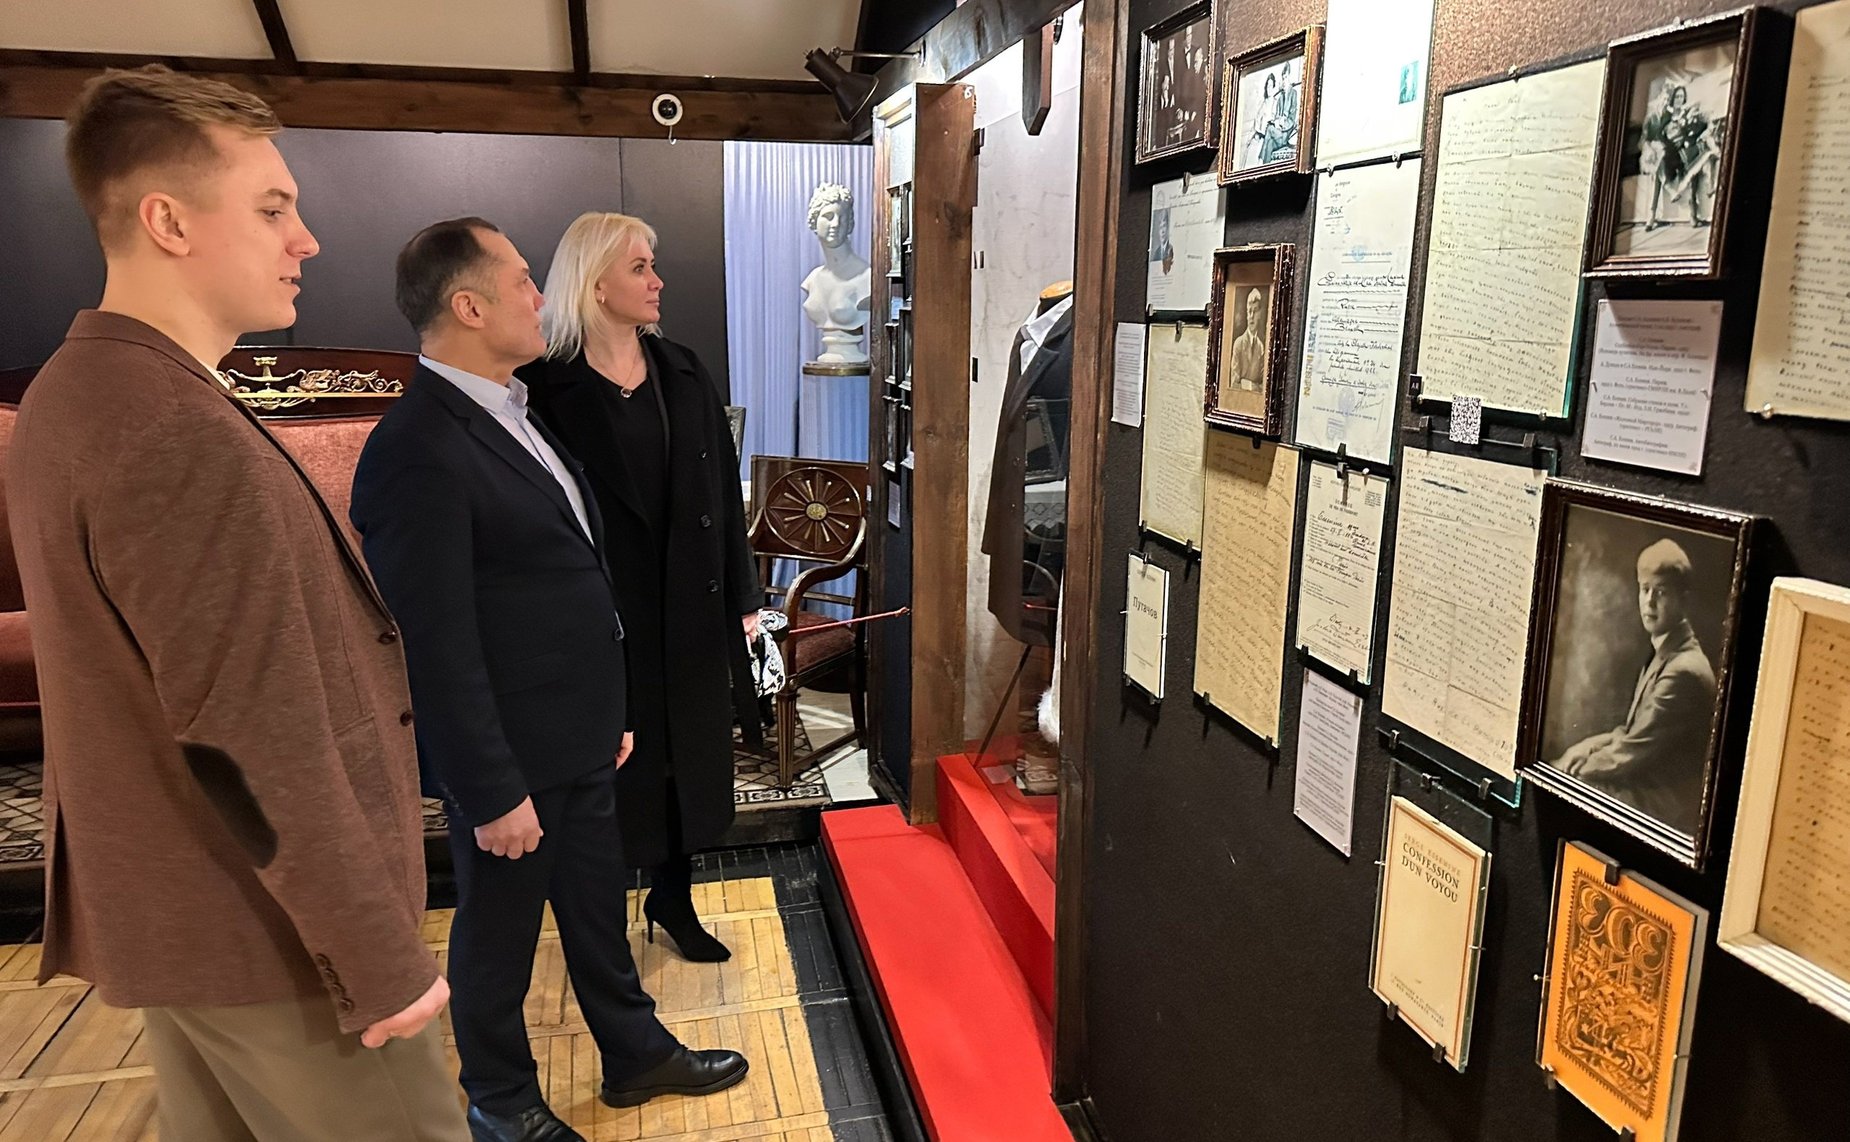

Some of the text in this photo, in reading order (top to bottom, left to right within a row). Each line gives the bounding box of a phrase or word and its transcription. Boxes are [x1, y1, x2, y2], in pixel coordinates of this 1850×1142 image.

[1133, 597, 1158, 619] Пугачов
[1403, 842, 1460, 888] CONFESSION
[1425, 872, 1458, 903] VOYOU
